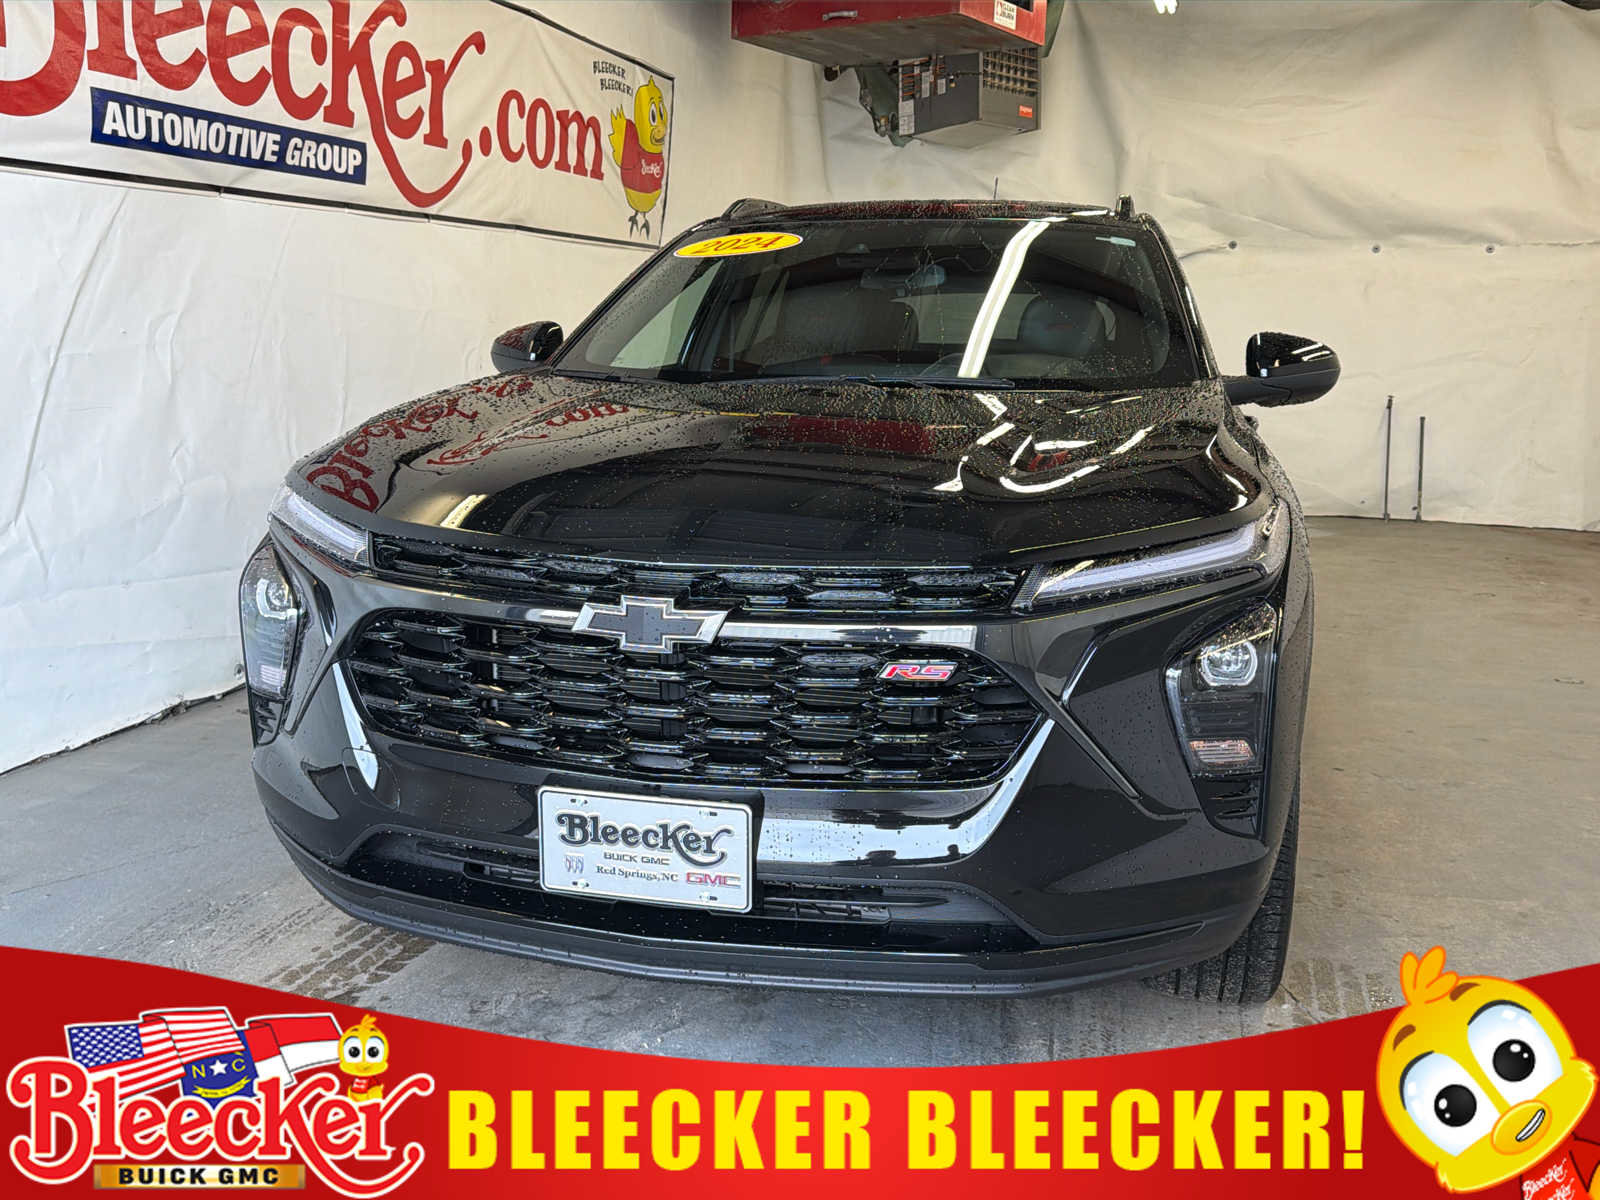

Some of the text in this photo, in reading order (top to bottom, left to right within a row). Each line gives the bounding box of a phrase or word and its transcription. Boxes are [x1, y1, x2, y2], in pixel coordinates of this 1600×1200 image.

[102, 101, 362, 176] AUTOMOTIVE GROUP
[690, 235, 784, 254] 2024
[879, 663, 954, 680] RS
[556, 812, 734, 867] Bleecker
[603, 851, 671, 866] BUICK GMC
[596, 865, 617, 875] Red
[686, 871, 741, 889] GMC
